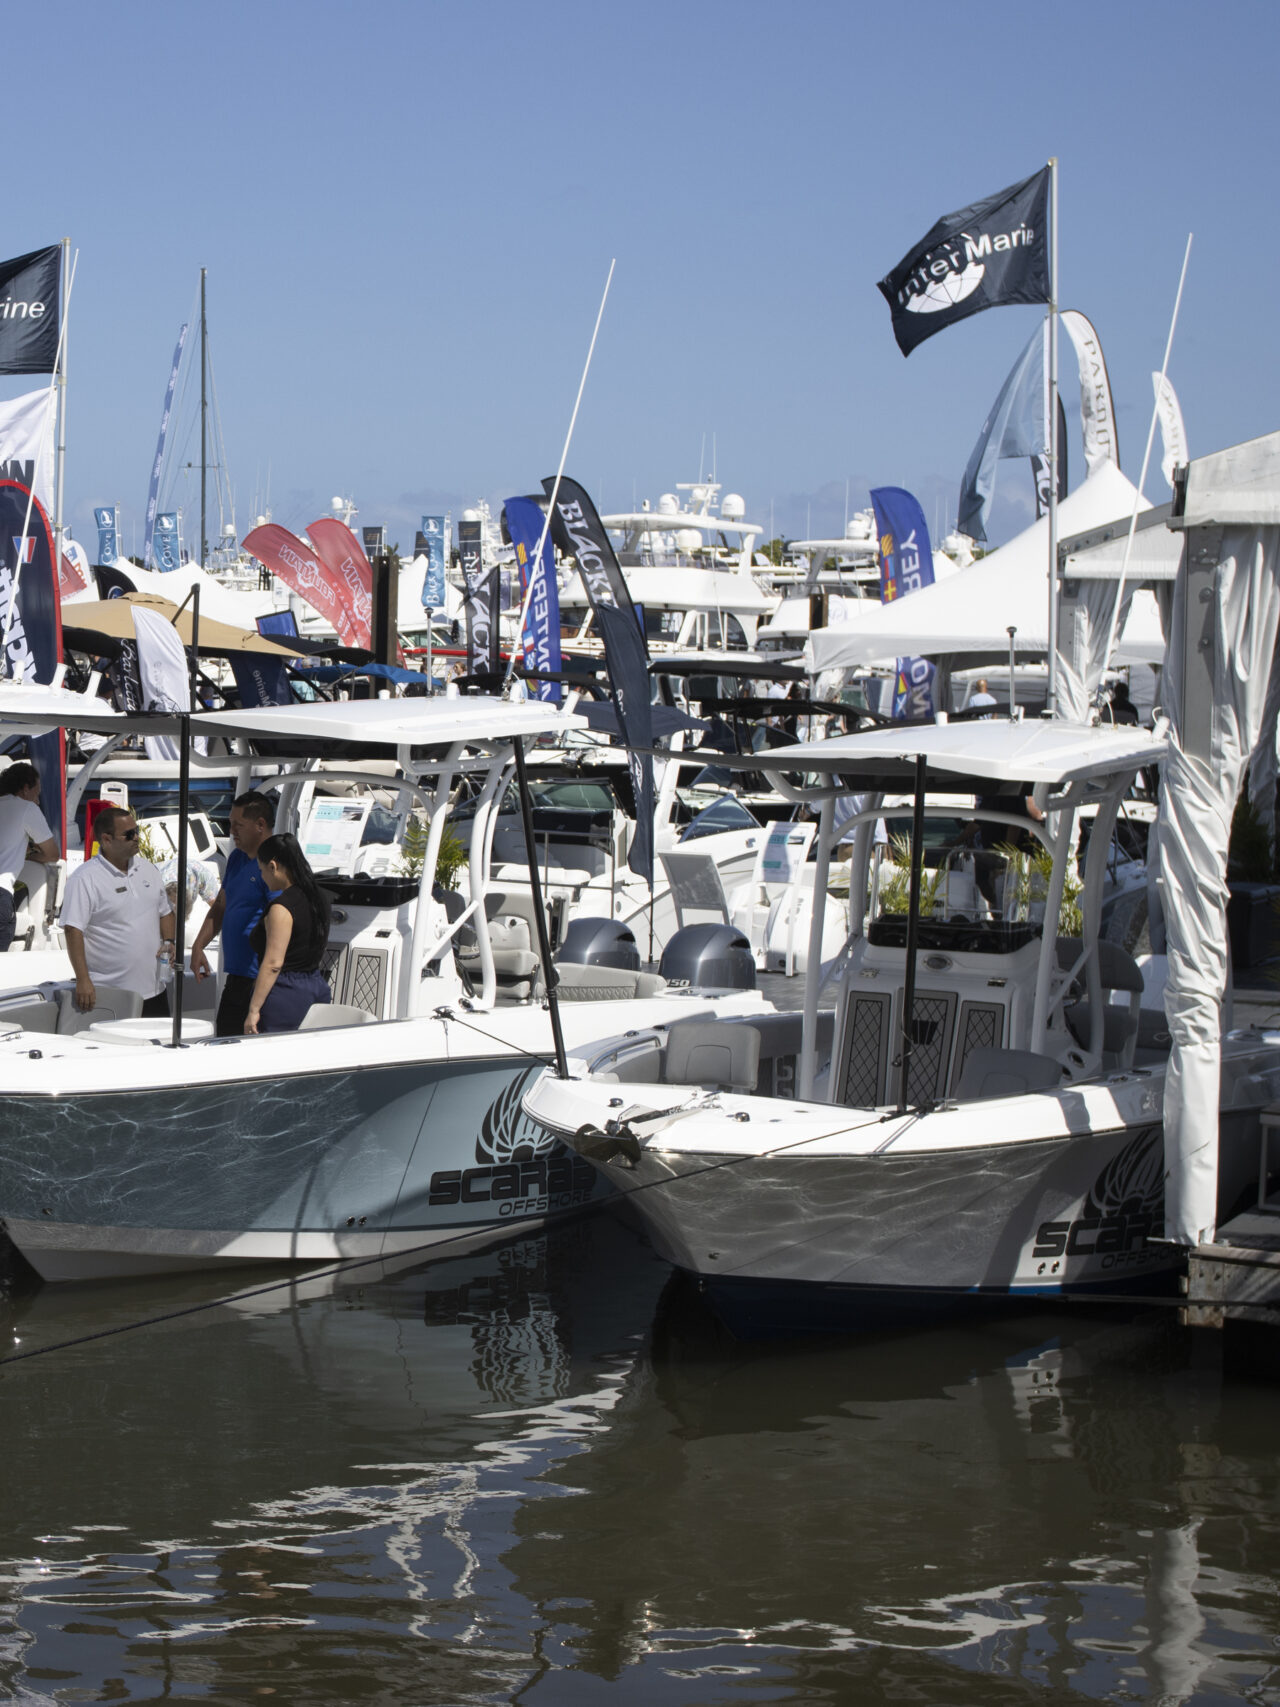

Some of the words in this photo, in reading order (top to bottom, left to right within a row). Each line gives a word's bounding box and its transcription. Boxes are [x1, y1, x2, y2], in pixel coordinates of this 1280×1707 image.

[426, 576, 440, 604] BACK
[429, 1157, 597, 1206] SCARAB
[499, 1190, 593, 1216] OFFSHORE
